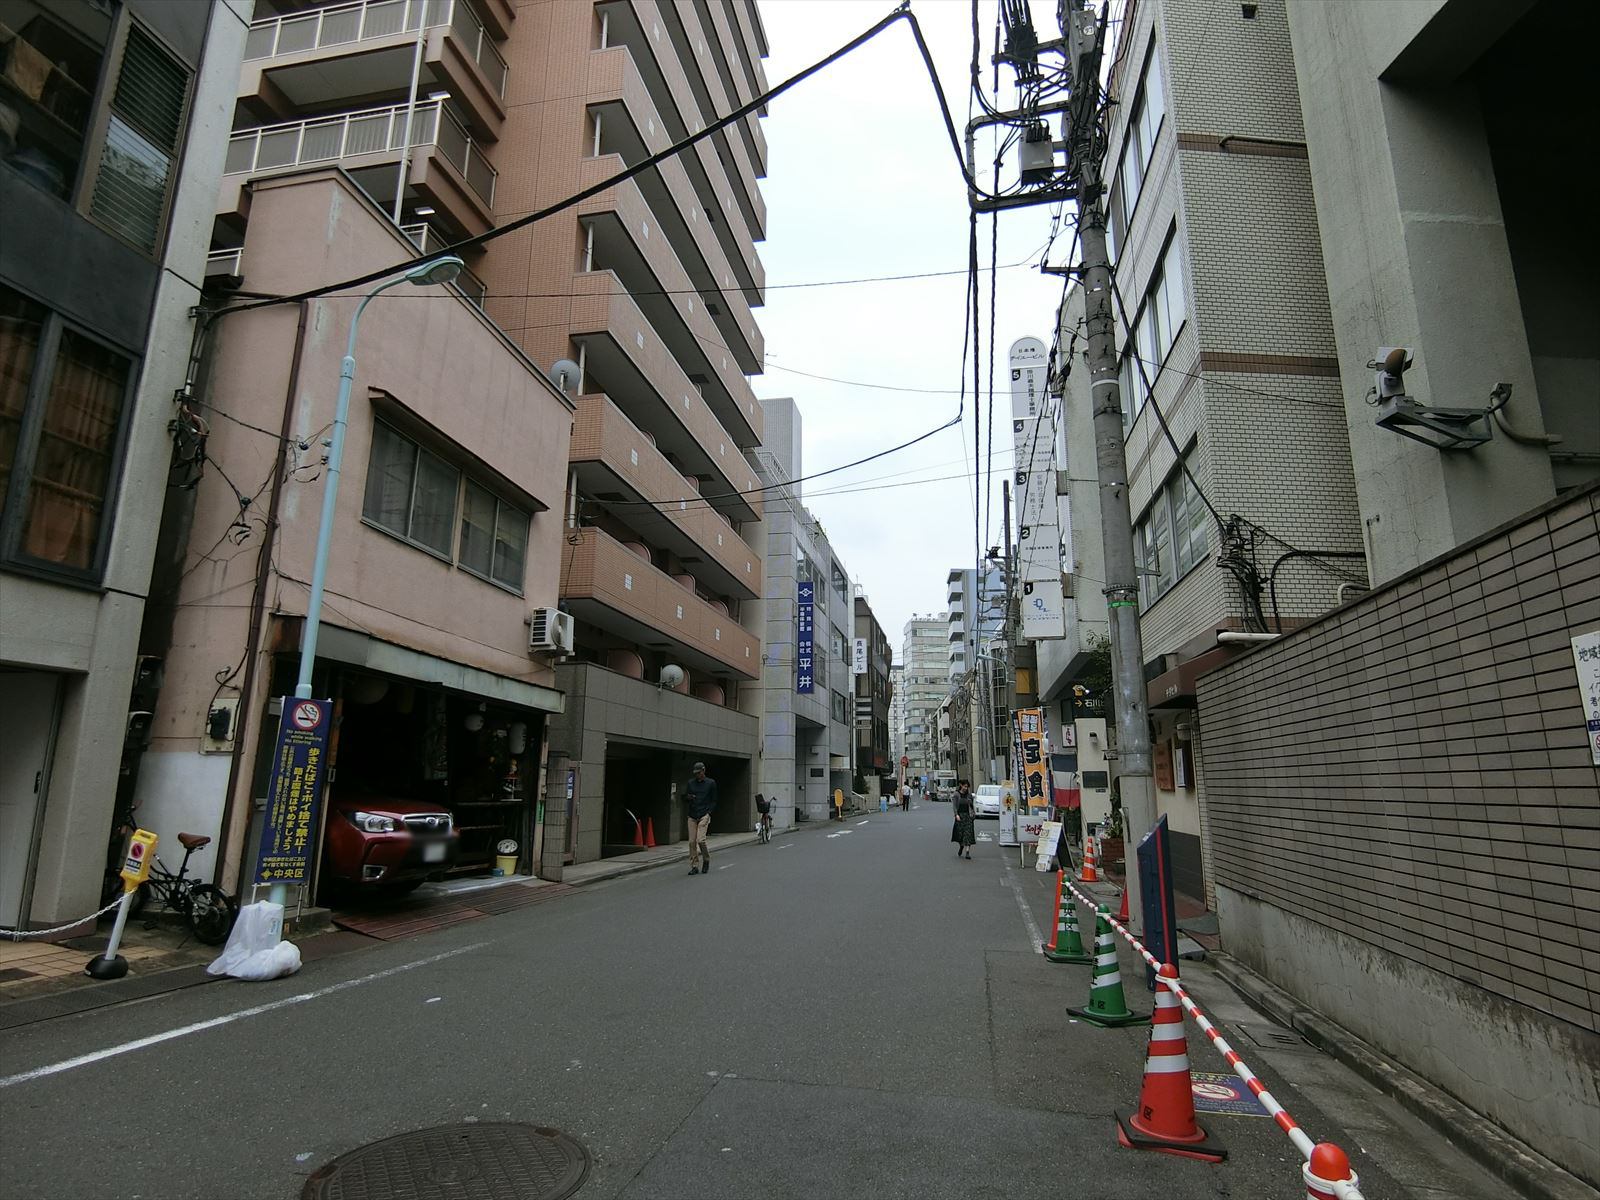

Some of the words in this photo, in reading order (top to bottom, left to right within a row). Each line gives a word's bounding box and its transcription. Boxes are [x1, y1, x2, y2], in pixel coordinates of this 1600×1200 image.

[1578, 644, 1600, 662] 地域
[799, 658, 811, 688] 平井
[273, 868, 304, 879] 中央区
